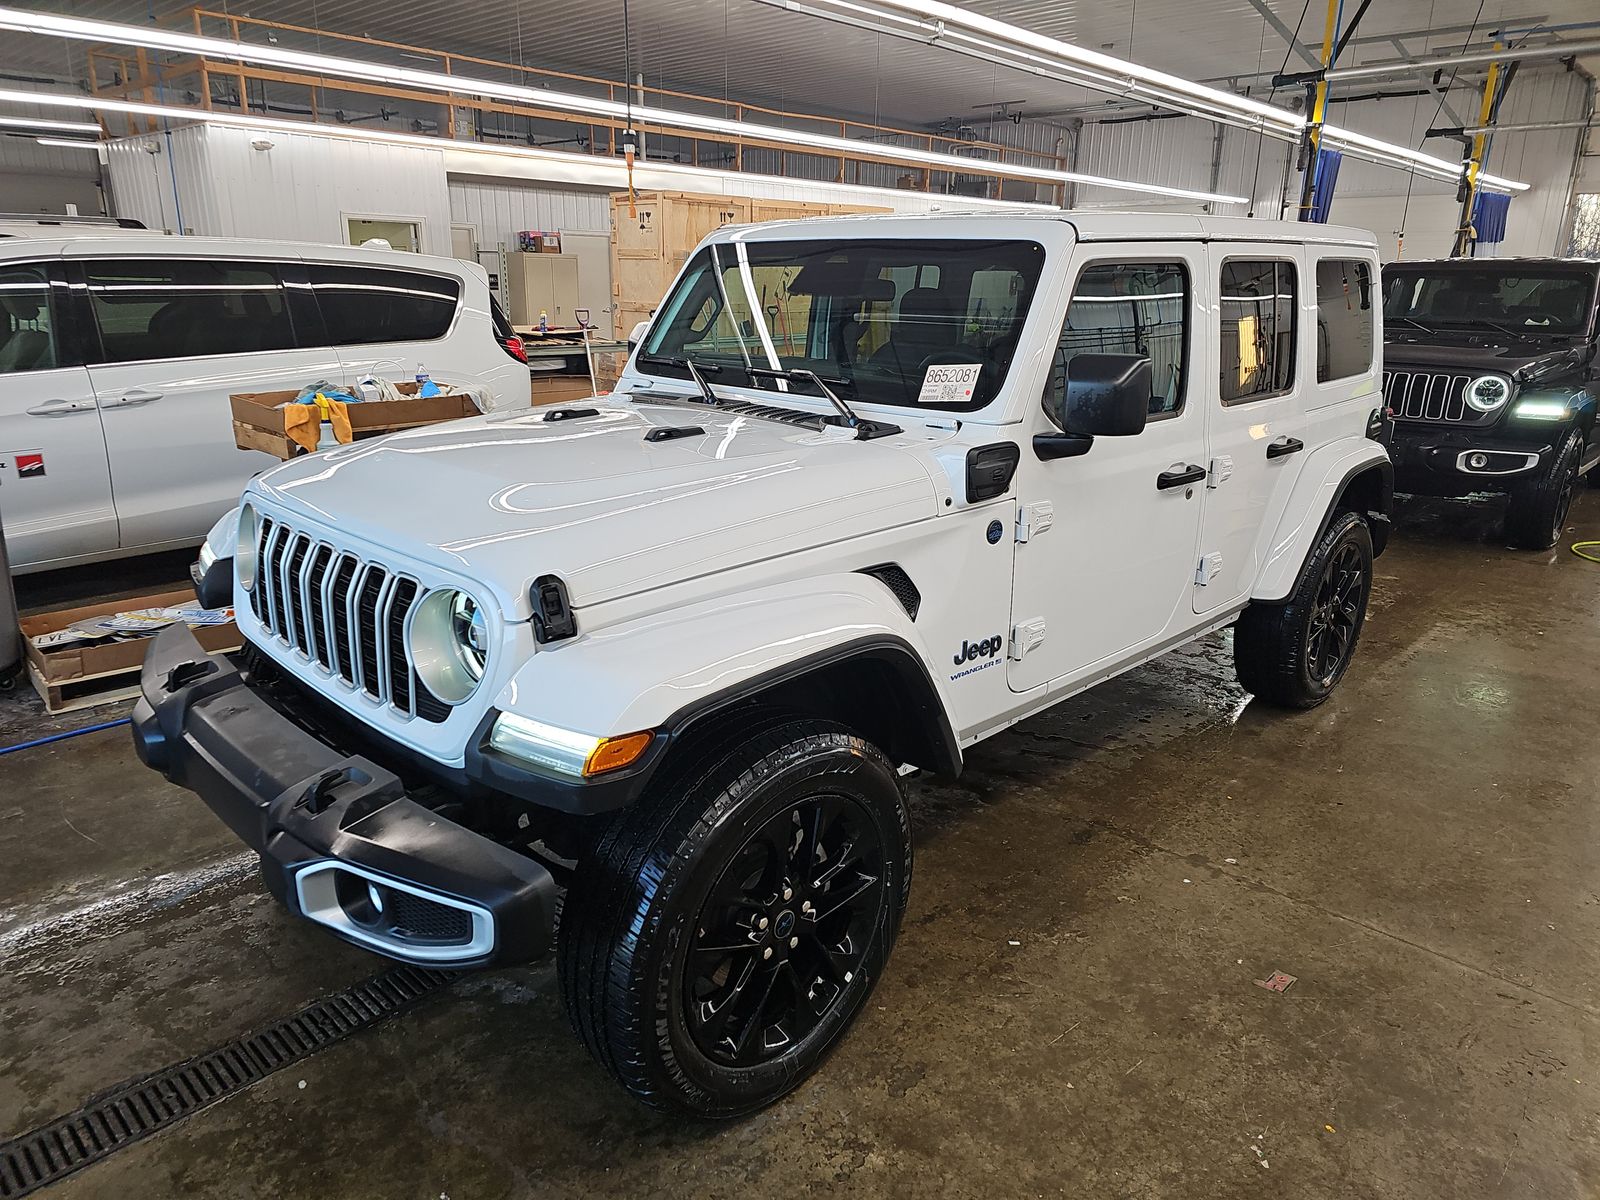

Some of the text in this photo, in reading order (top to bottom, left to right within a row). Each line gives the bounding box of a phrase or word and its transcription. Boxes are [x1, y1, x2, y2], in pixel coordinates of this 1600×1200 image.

[926, 368, 978, 383] 8652081
[953, 634, 1003, 666] Jeep
[950, 660, 995, 681] WRANGLER
